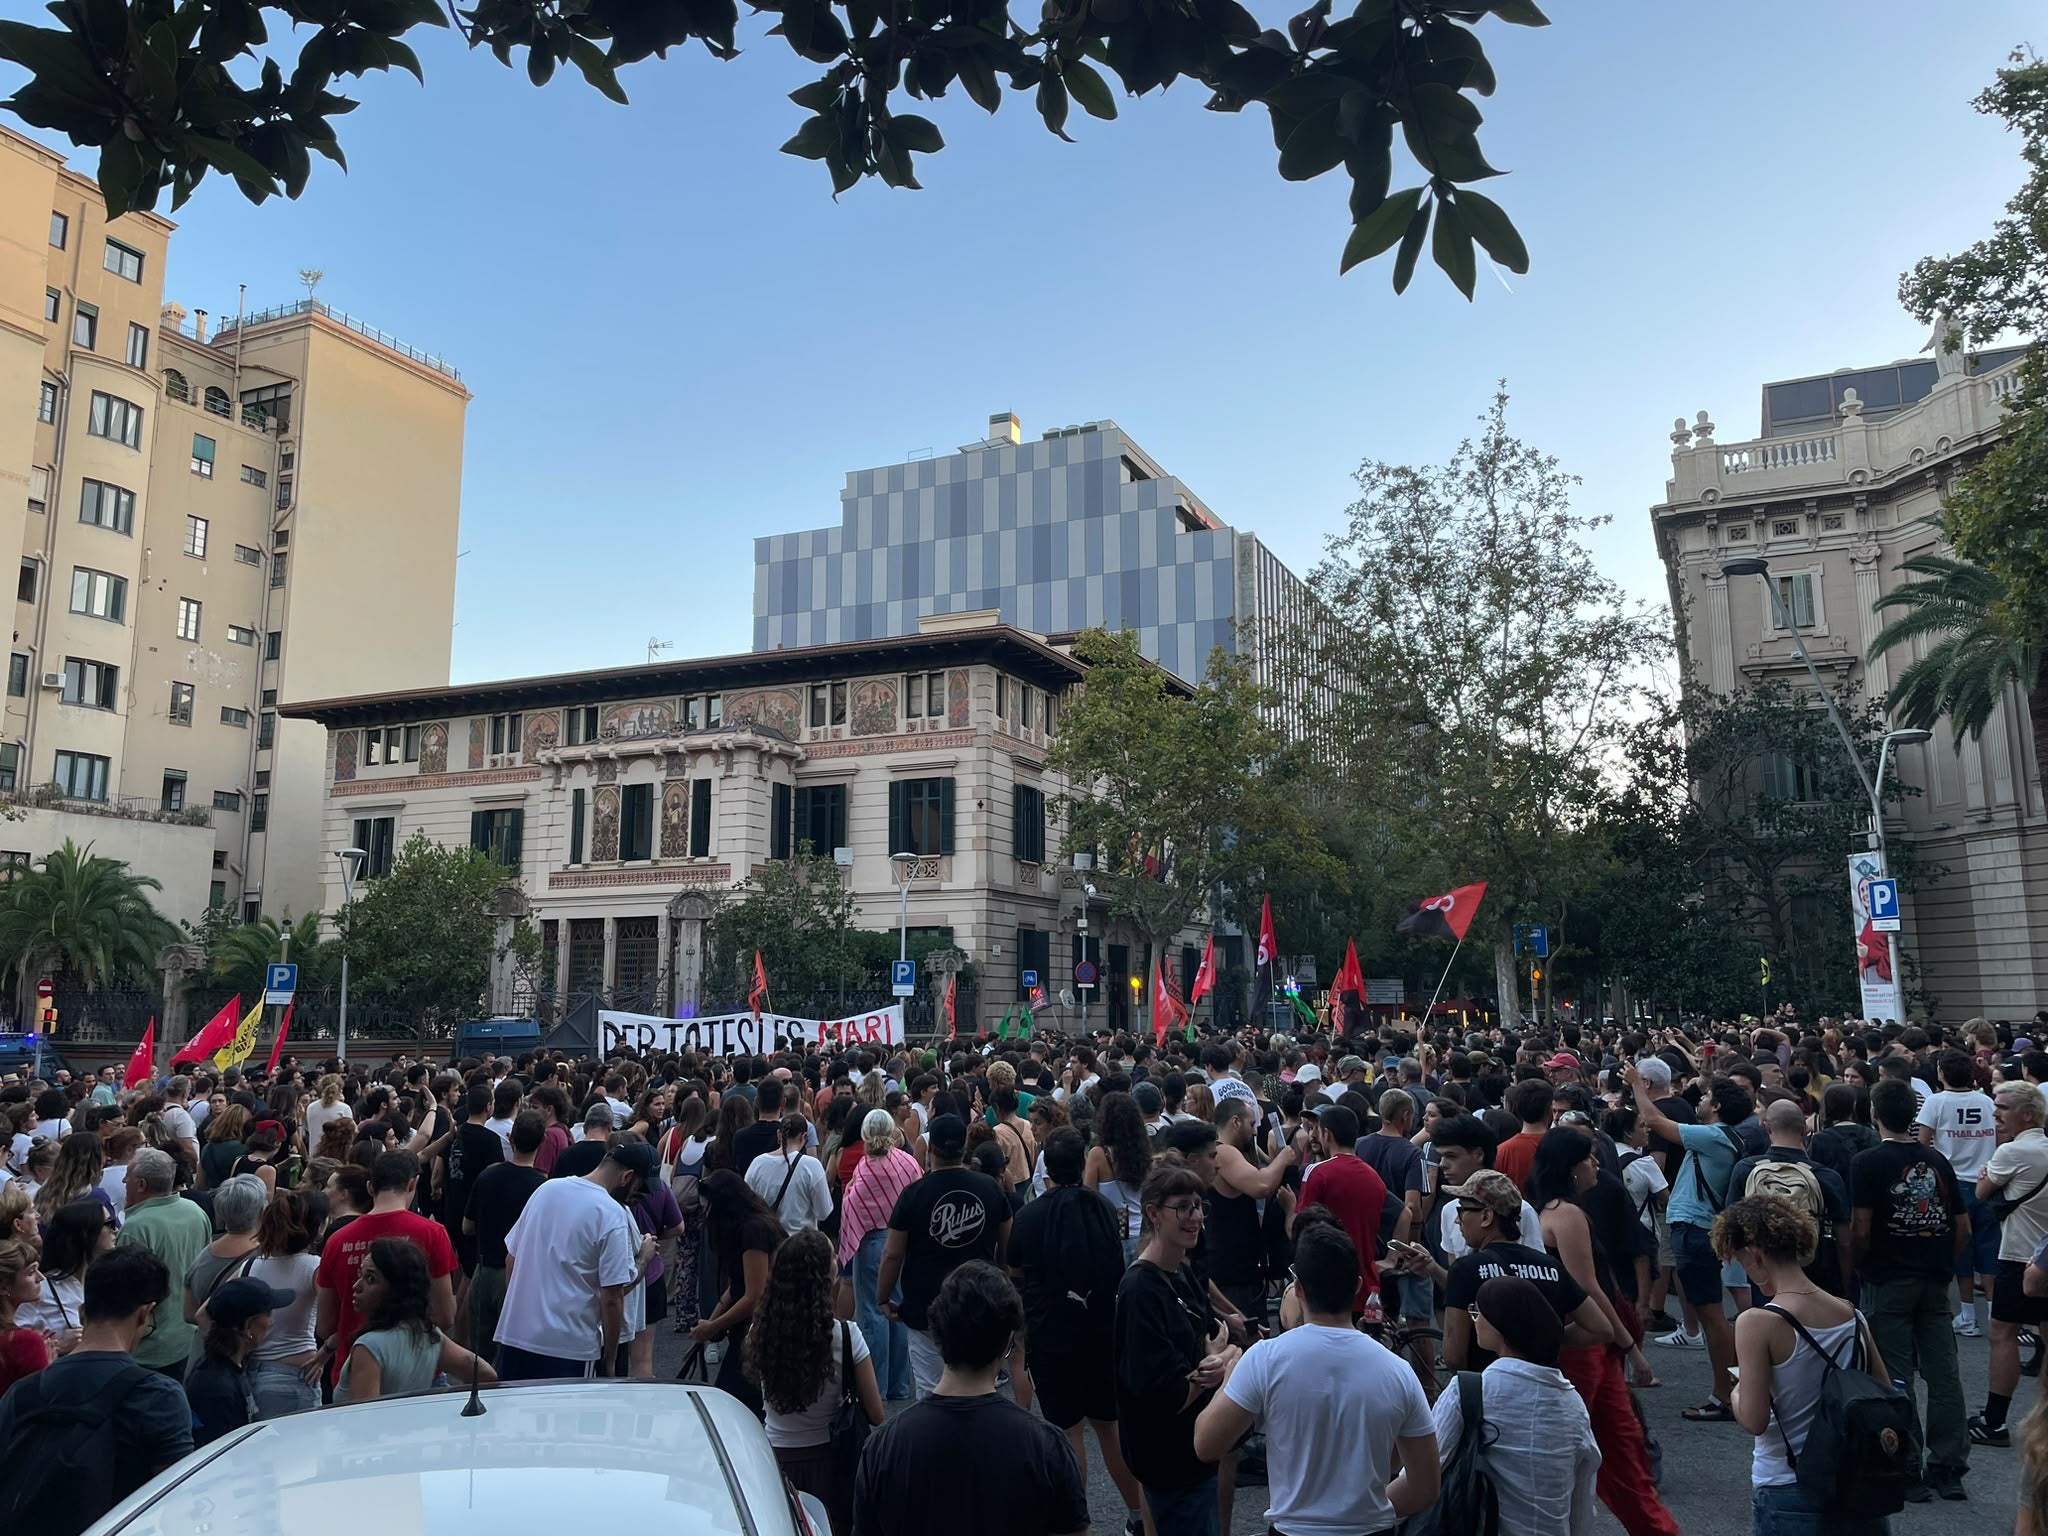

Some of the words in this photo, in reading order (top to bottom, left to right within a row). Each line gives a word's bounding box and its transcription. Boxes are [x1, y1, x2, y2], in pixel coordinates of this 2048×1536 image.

[1873, 884, 1892, 915] P
[272, 967, 290, 988] P
[897, 963, 910, 982] P
[663, 1017, 754, 1058] TOTES
[818, 1014, 892, 1048] MARI
[1218, 1082, 1236, 1097] GOOD
[1956, 1107, 1982, 1125] 15
[1946, 1128, 1995, 1138] THAILAND
